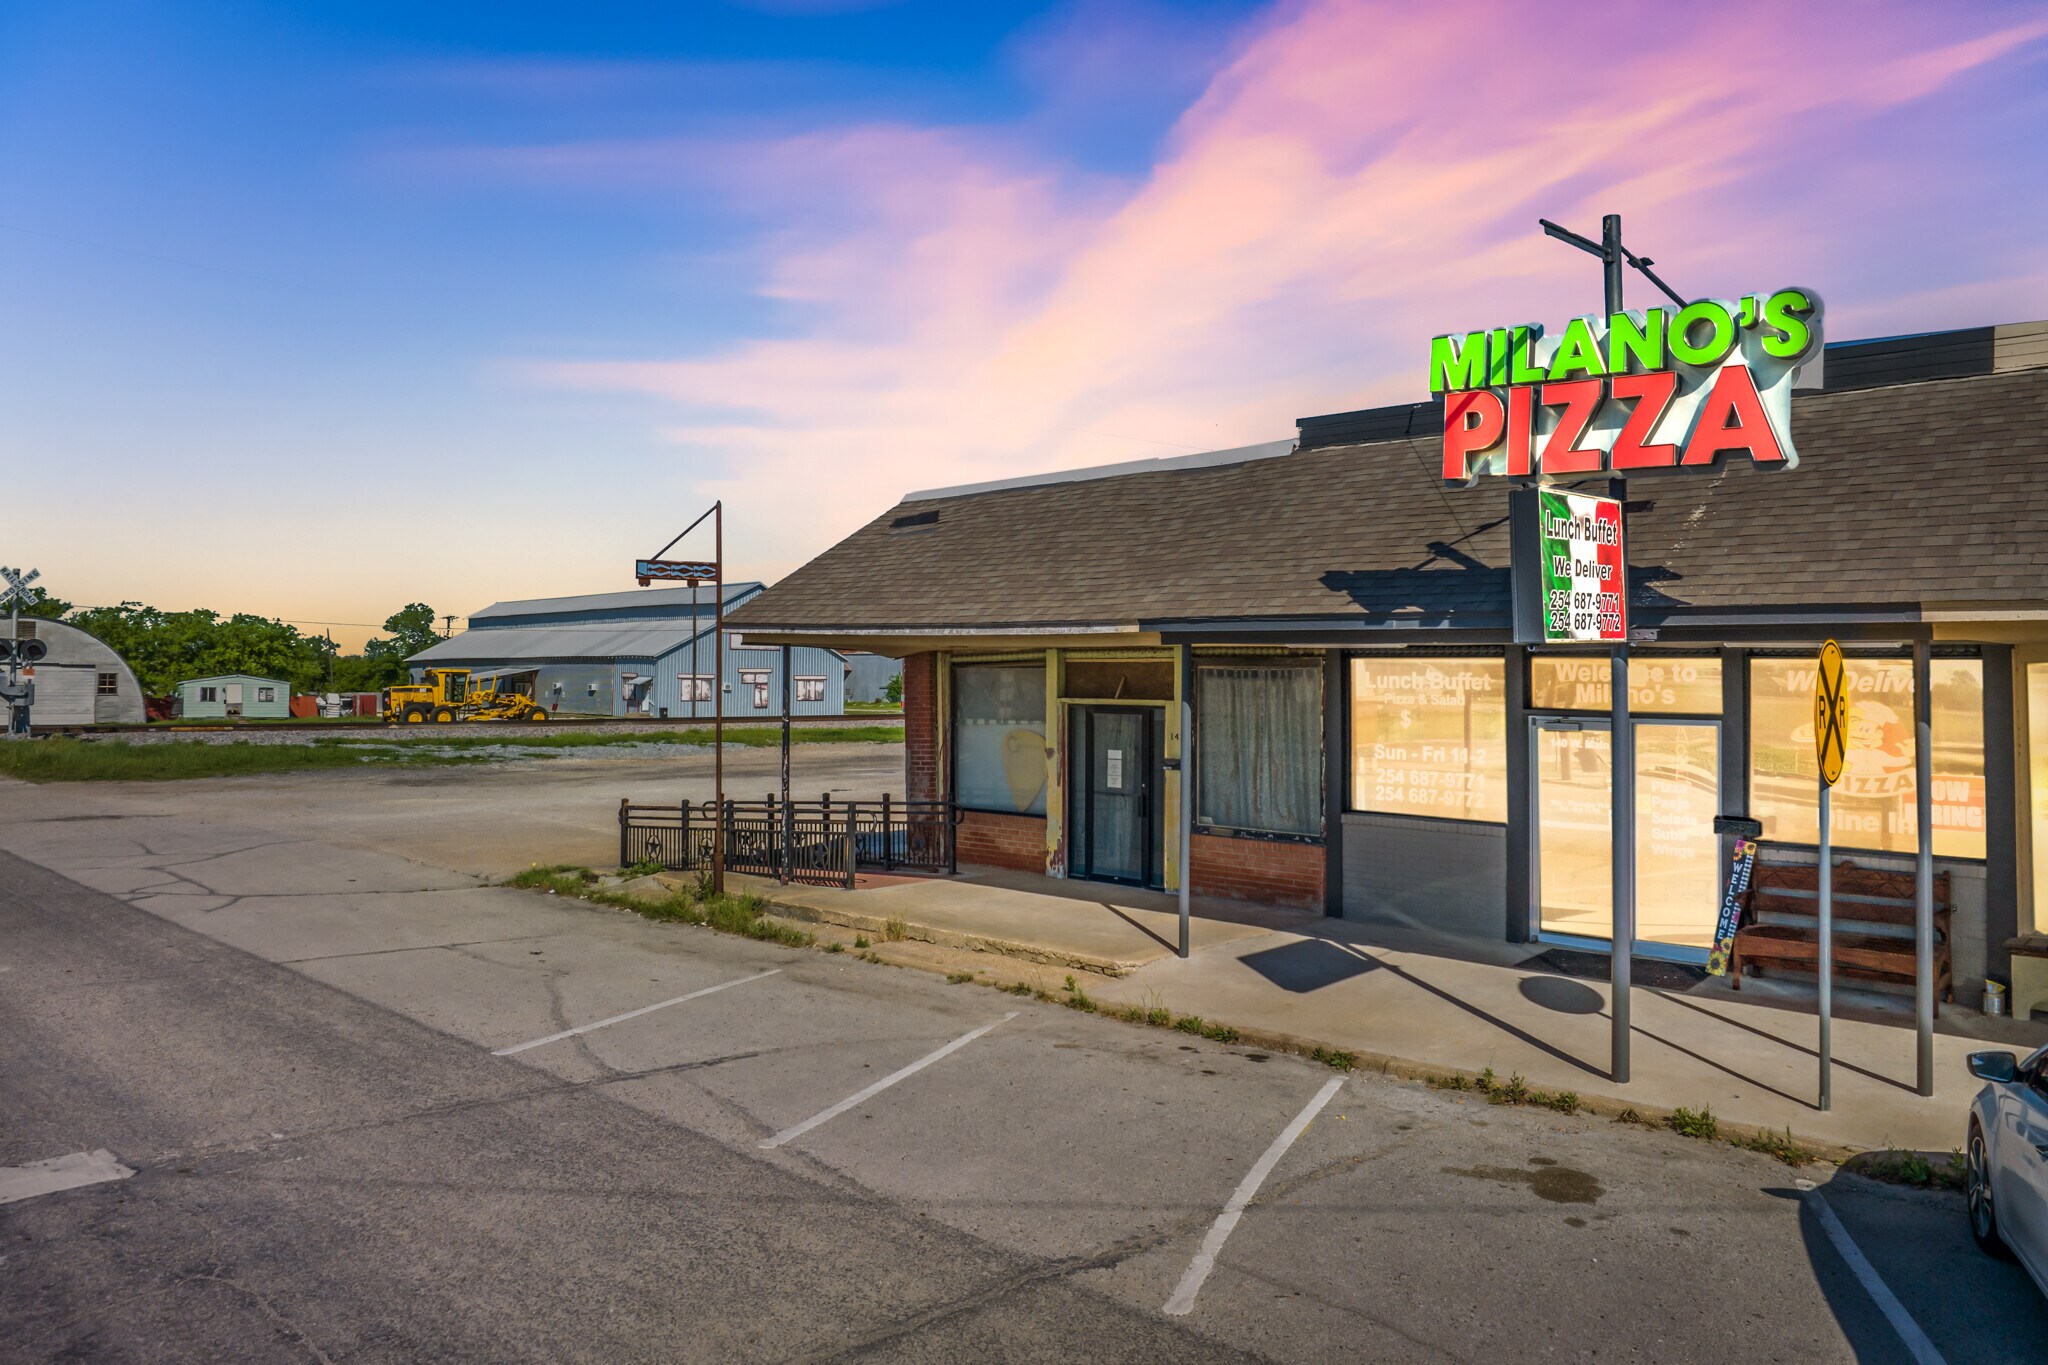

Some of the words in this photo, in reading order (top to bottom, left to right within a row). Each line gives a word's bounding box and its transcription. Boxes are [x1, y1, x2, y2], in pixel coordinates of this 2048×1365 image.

[1429, 290, 1812, 392] MILANO'S
[1442, 364, 1789, 480] PIZZA
[1545, 510, 1581, 540] Lunch
[1584, 517, 1618, 545] Buffet
[1553, 556, 1572, 578] We
[1575, 558, 1612, 580] Deliver
[1549, 591, 1571, 609] 254
[1574, 592, 1620, 611] 687-9771
[1549, 612, 1571, 631] 254
[1574, 613, 1621, 631] 687-9772
[1365, 672, 1424, 689] Lunch
[1430, 672, 1492, 691] Buffet
[1672, 663, 1697, 683] to
[1787, 670, 1816, 691] W
[1384, 693, 1415, 705] Pizza
[1431, 693, 1465, 706] Salad
[1576, 683, 1676, 704] Milno's
[1818, 695, 1826, 729] R
[1840, 696, 1846, 728] R
[1374, 744, 1407, 760] Sun
[1422, 745, 1446, 763] Fri
[1376, 769, 1405, 785] 254
[1409, 770, 1486, 789] 687-9771
[1843, 774, 1914, 793] IZZA
[1375, 786, 1404, 802] 254
[1408, 788, 1486, 808] 687-9772
[1931, 779, 1970, 802] OW
[1716, 861, 1744, 940] WELCOME
